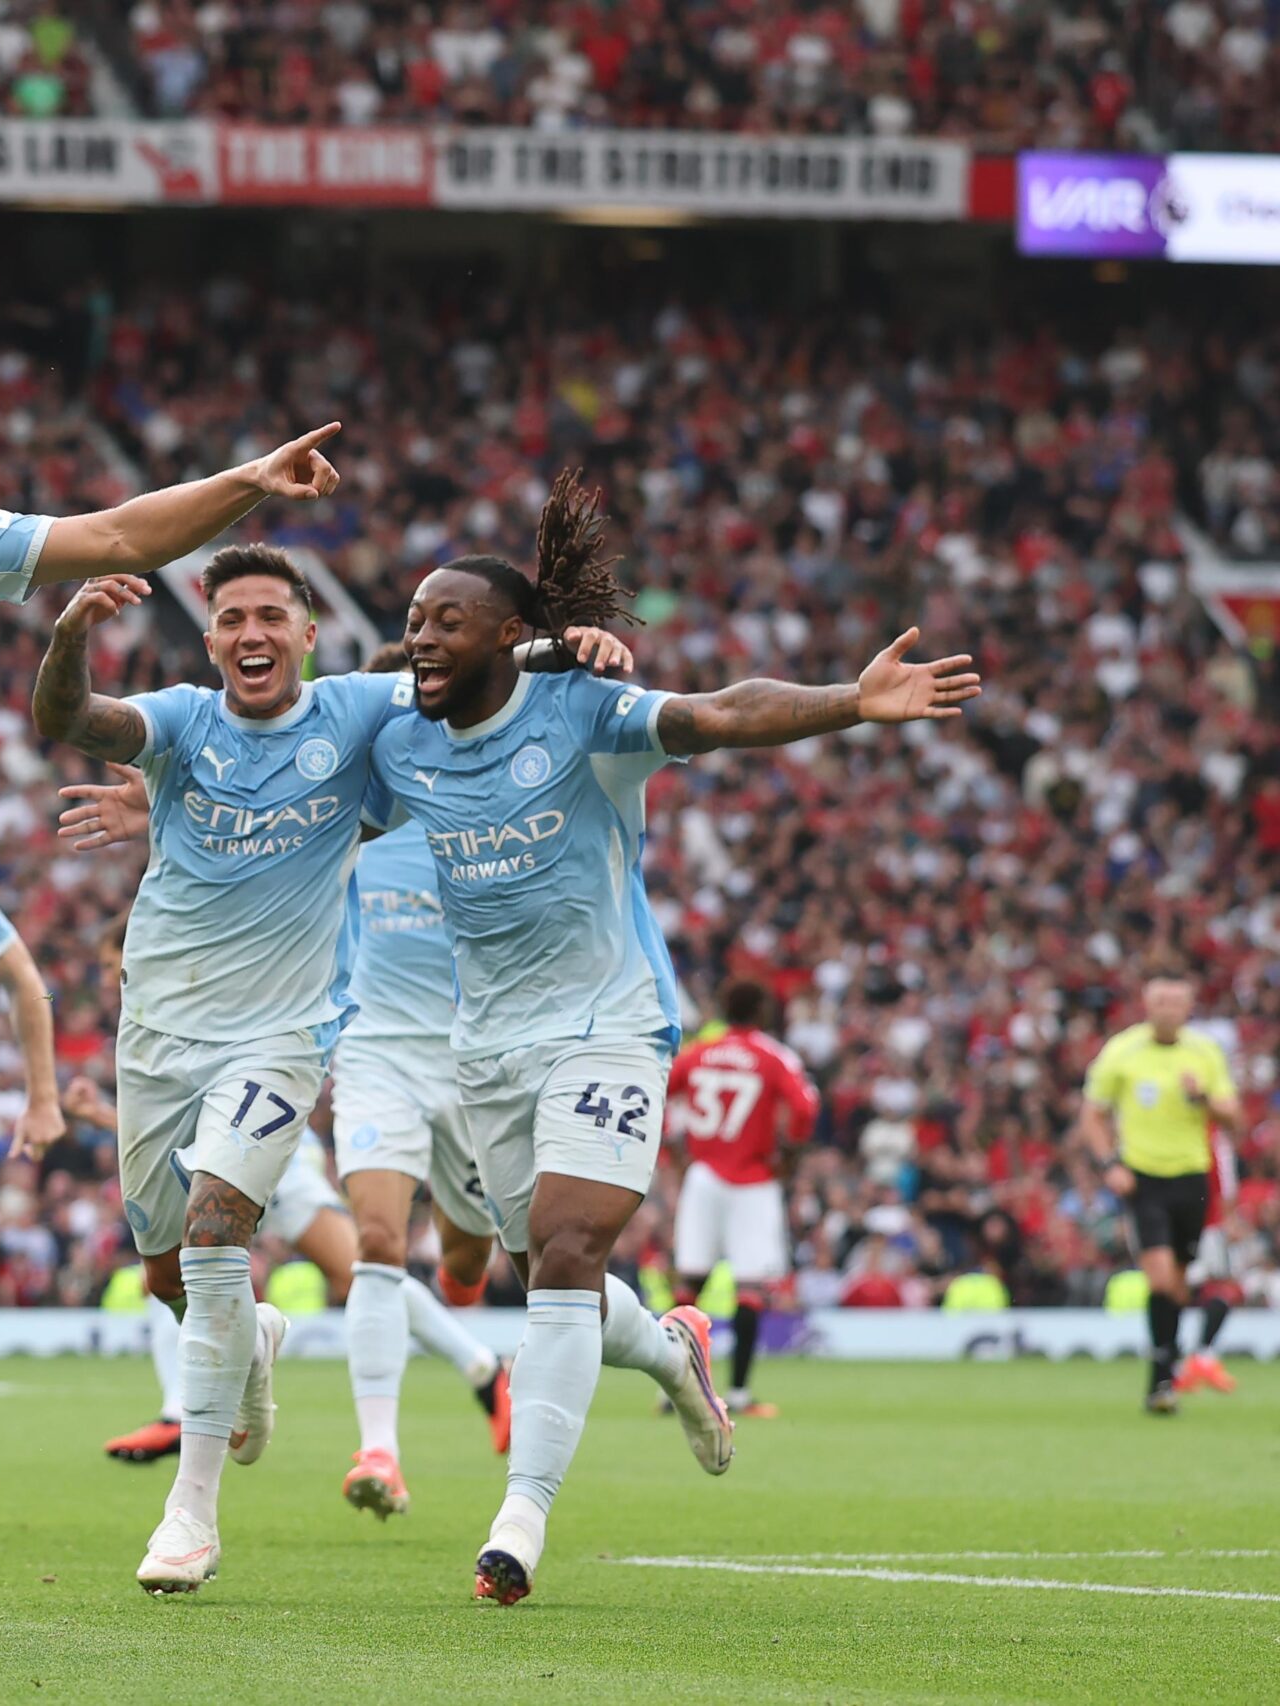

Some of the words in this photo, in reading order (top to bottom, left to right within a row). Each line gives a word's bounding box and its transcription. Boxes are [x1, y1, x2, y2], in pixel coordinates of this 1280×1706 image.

[22, 132, 117, 177] LAW
[226, 129, 308, 189] THE
[321, 131, 421, 188] KING
[444, 142, 496, 186] OF
[512, 144, 584, 188] THE
[602, 147, 847, 197] STRETFORD
[859, 152, 937, 201] END
[1026, 176, 1147, 233] VAR
[184, 791, 339, 835] ETIHAD
[201, 834, 304, 856] AIRWAYS
[451, 853, 536, 881] AIRWAYS
[230, 1080, 297, 1140] 17
[574, 1082, 650, 1143] 42
[687, 1066, 764, 1142] 37
